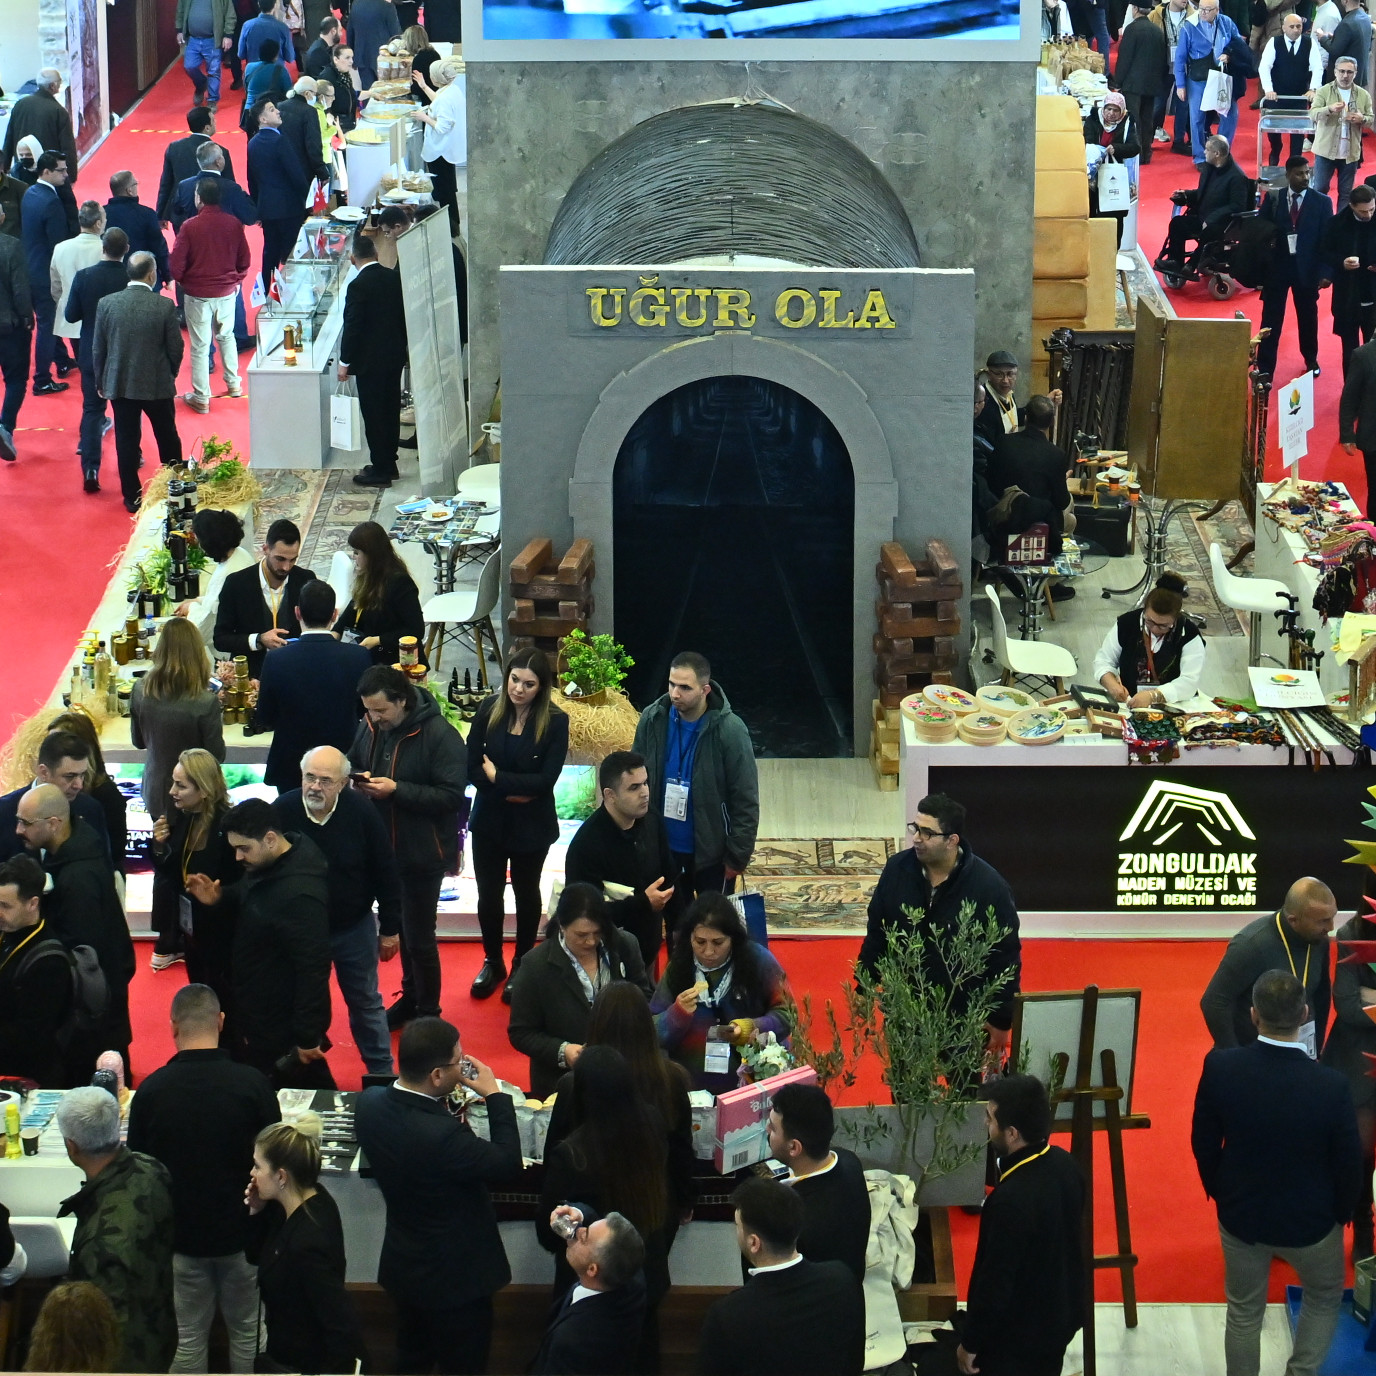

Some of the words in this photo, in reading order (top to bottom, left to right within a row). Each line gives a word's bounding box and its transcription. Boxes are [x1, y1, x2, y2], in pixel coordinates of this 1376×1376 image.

[586, 275, 756, 329] UĞUR
[775, 287, 896, 329] OLA
[1117, 852, 1257, 875] ZONGULDAK
[1117, 877, 1167, 891] MADEN
[1175, 874, 1229, 891] MÜZESİ
[1237, 877, 1257, 891] VE
[1116, 892, 1157, 906] KÖMÜR
[1163, 892, 1215, 906] DENEYİM
[1220, 891, 1257, 906] OCAĞI
